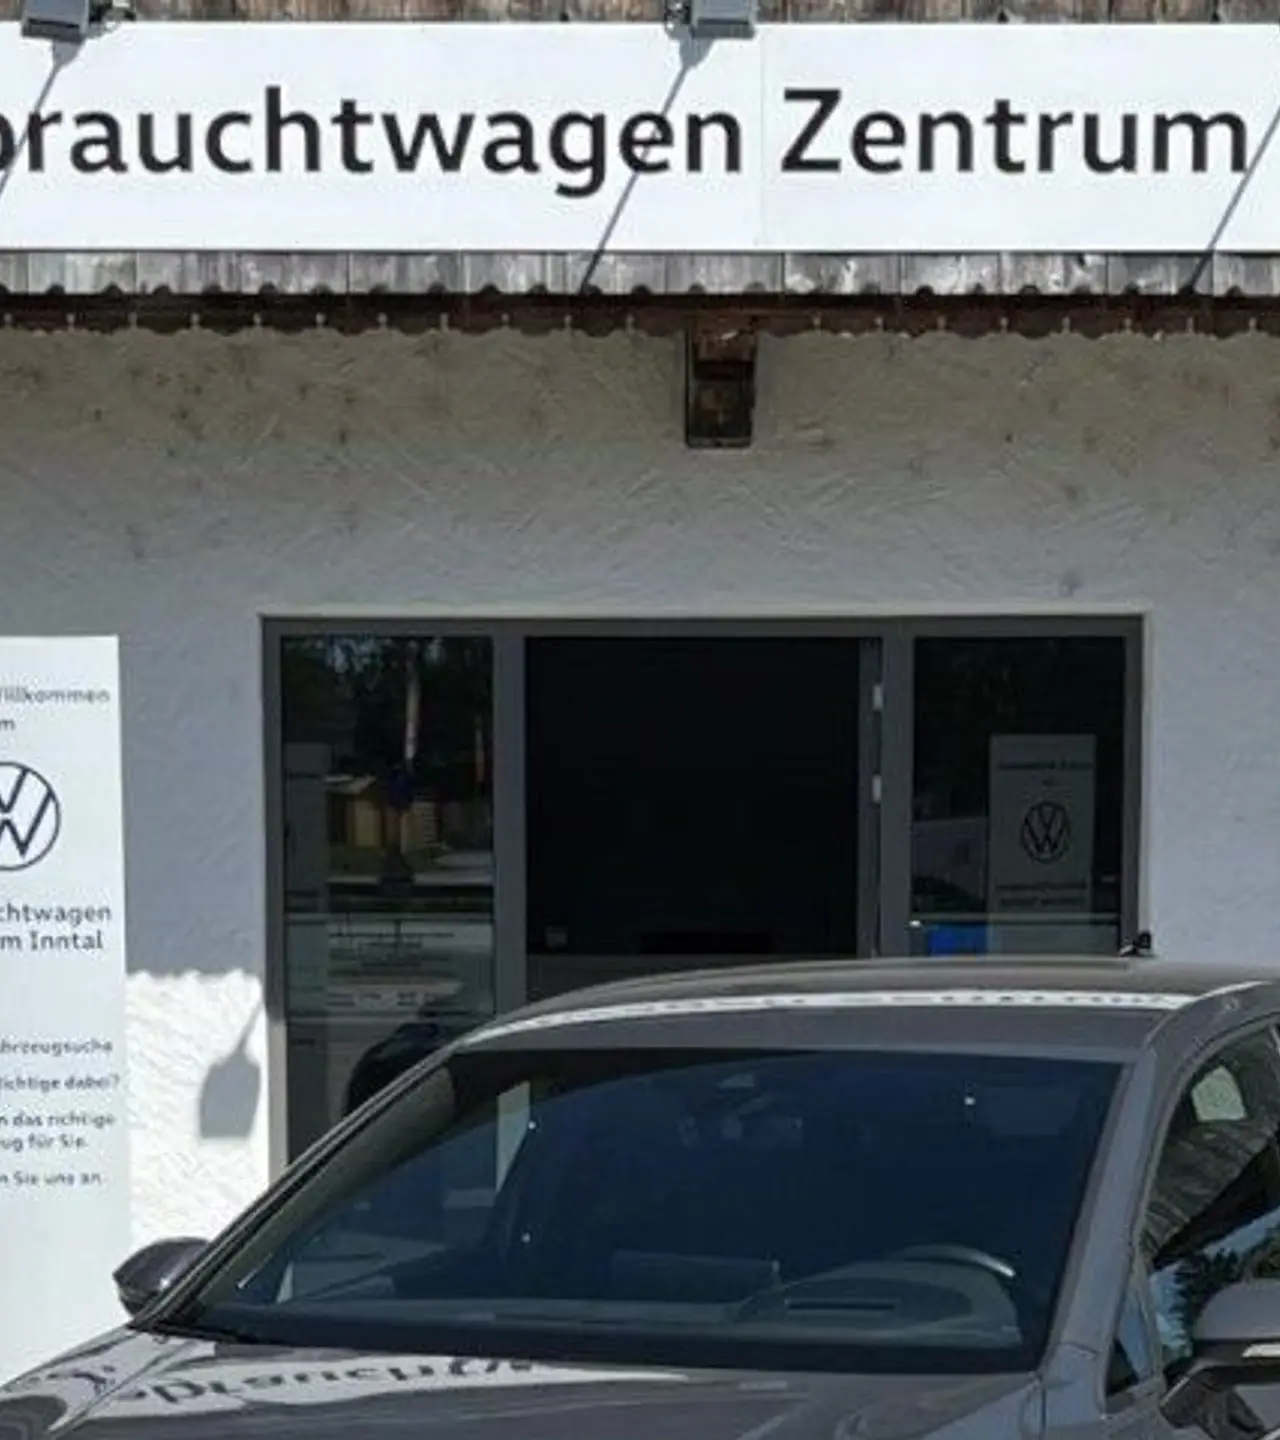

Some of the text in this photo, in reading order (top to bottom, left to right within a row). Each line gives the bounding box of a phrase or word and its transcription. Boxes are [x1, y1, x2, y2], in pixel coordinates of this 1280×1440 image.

[780, 88, 1249, 173] Zentrum
[29, 930, 104, 951] Inntal
[13, 1112, 43, 1127] das
[48, 1112, 116, 1129] richtige
[29, 1133, 53, 1149] für
[13, 1170, 39, 1186] Sie
[45, 1173, 75, 1186] uns
